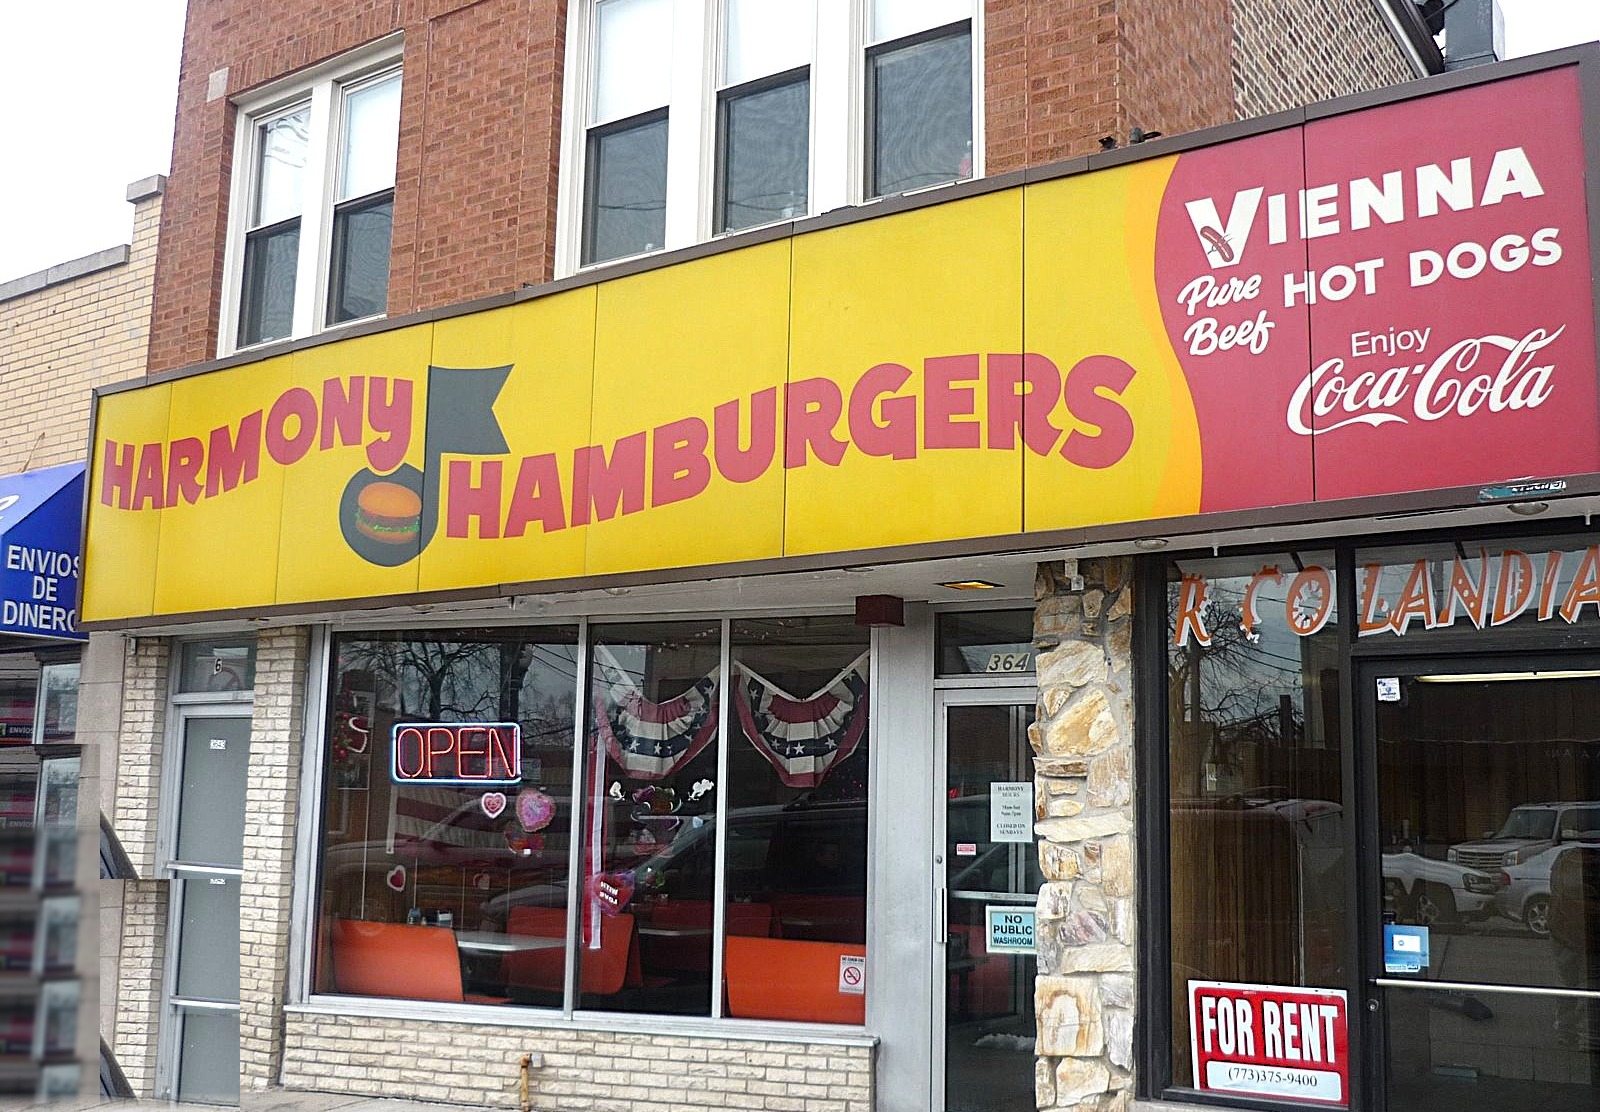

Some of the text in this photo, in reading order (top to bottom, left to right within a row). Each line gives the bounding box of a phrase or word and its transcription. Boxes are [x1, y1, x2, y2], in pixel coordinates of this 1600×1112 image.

[1184, 146, 1545, 269] VIENNA
[1283, 226, 1563, 308] HOT DOGS
[1177, 273, 1262, 316] Pure
[1183, 309, 1275, 356] Beef
[1350, 326, 1431, 358] Enjoy
[1286, 323, 1567, 436] Coca-Cola
[101, 375, 415, 511] HARMONY
[446, 352, 1138, 539] HAMBURGERS
[32, 575, 58, 602] DE
[988, 653, 1030, 671] 364
[397, 727, 518, 777] OPEN
[992, 936, 1033, 946] WASHROOM
[993, 924, 1032, 935] PUBLIC
[1004, 914, 1023, 924] NO
[1200, 994, 1339, 1064] FOR RENT
[1227, 1066, 1318, 1087] (773)375-9400
